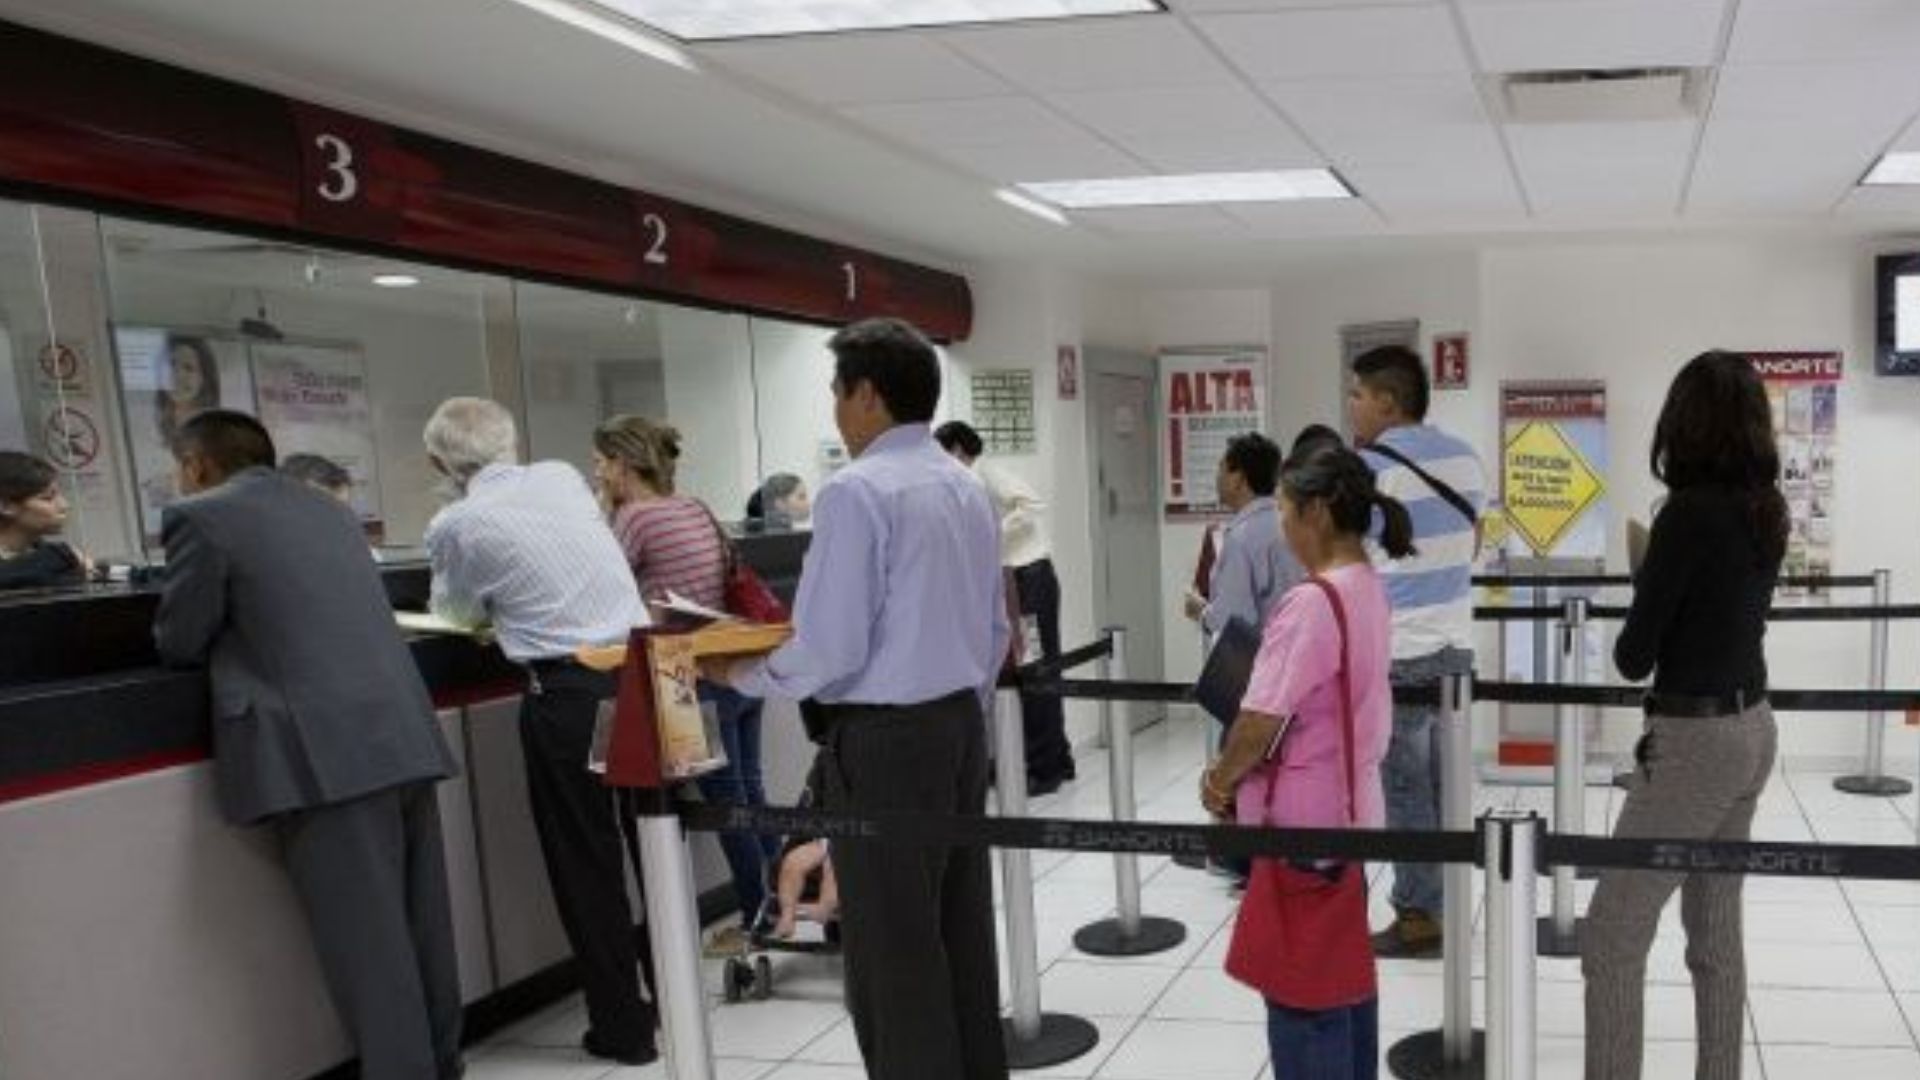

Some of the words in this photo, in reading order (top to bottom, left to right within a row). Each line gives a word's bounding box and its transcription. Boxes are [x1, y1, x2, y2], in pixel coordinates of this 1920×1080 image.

[315, 134, 358, 201] 3
[643, 213, 667, 264] 2
[842, 261, 857, 301] 1
[1171, 370, 1257, 413] ALTA
